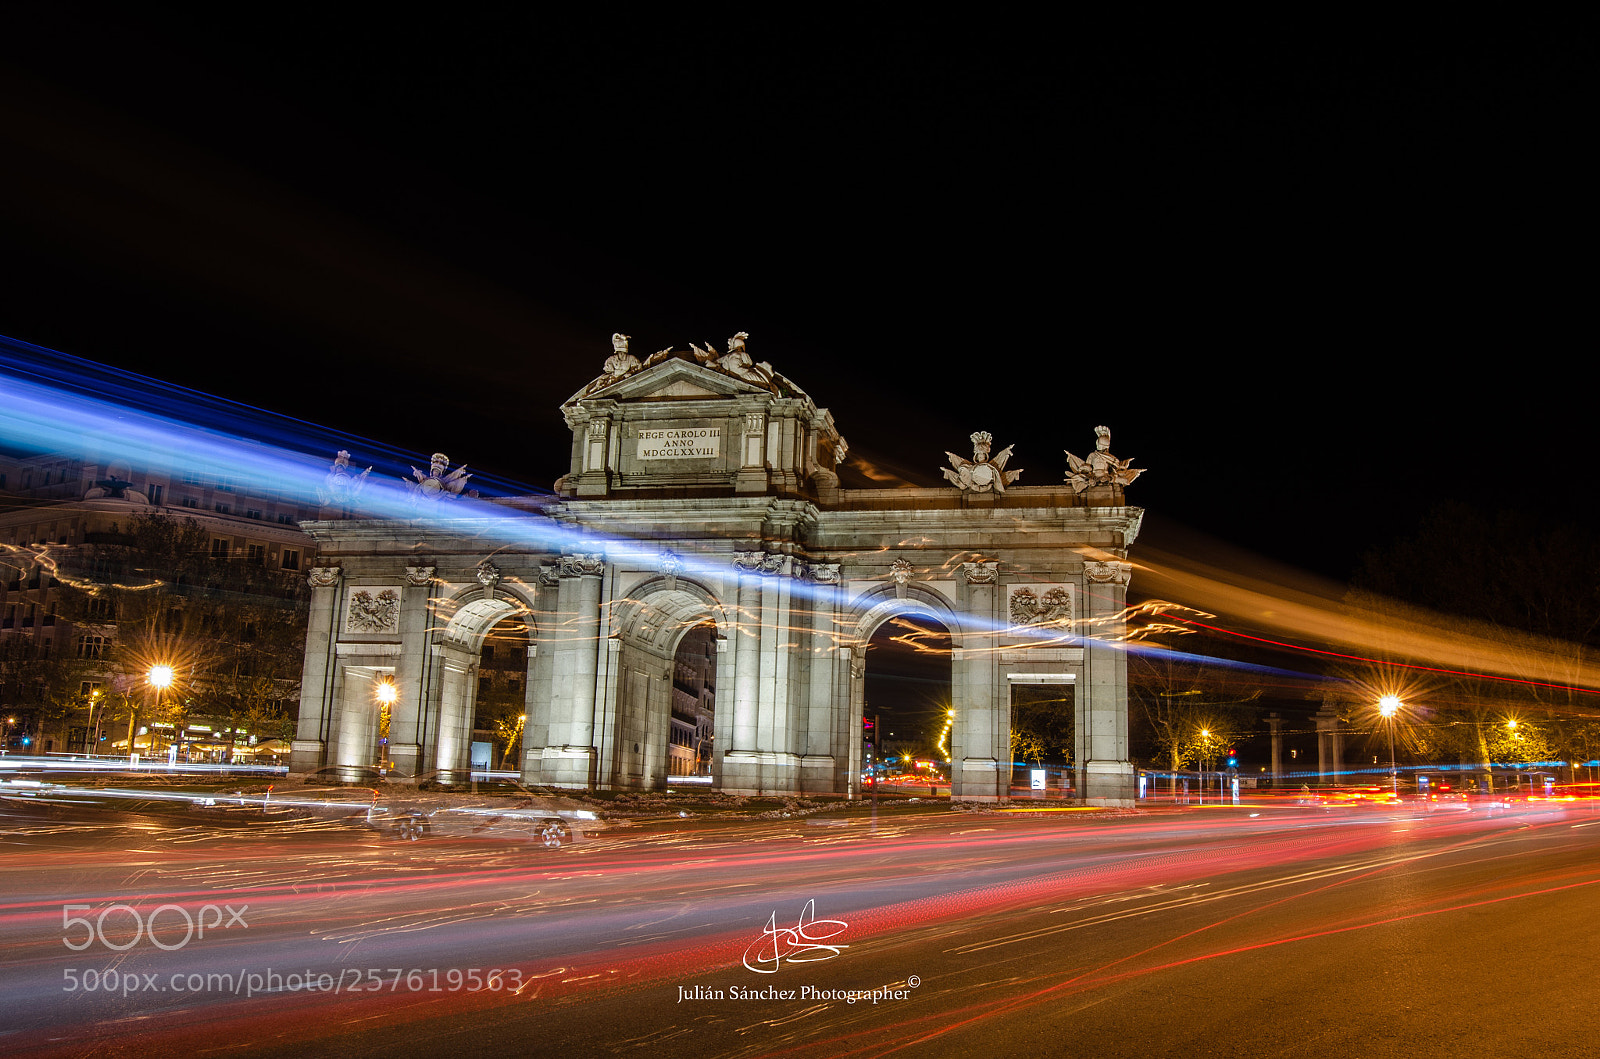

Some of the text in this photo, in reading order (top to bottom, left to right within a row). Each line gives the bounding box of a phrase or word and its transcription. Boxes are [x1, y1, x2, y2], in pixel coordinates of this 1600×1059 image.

[638, 429, 720, 439] REGE CAROLO III
[643, 448, 714, 457] MDCCLXXVIII
